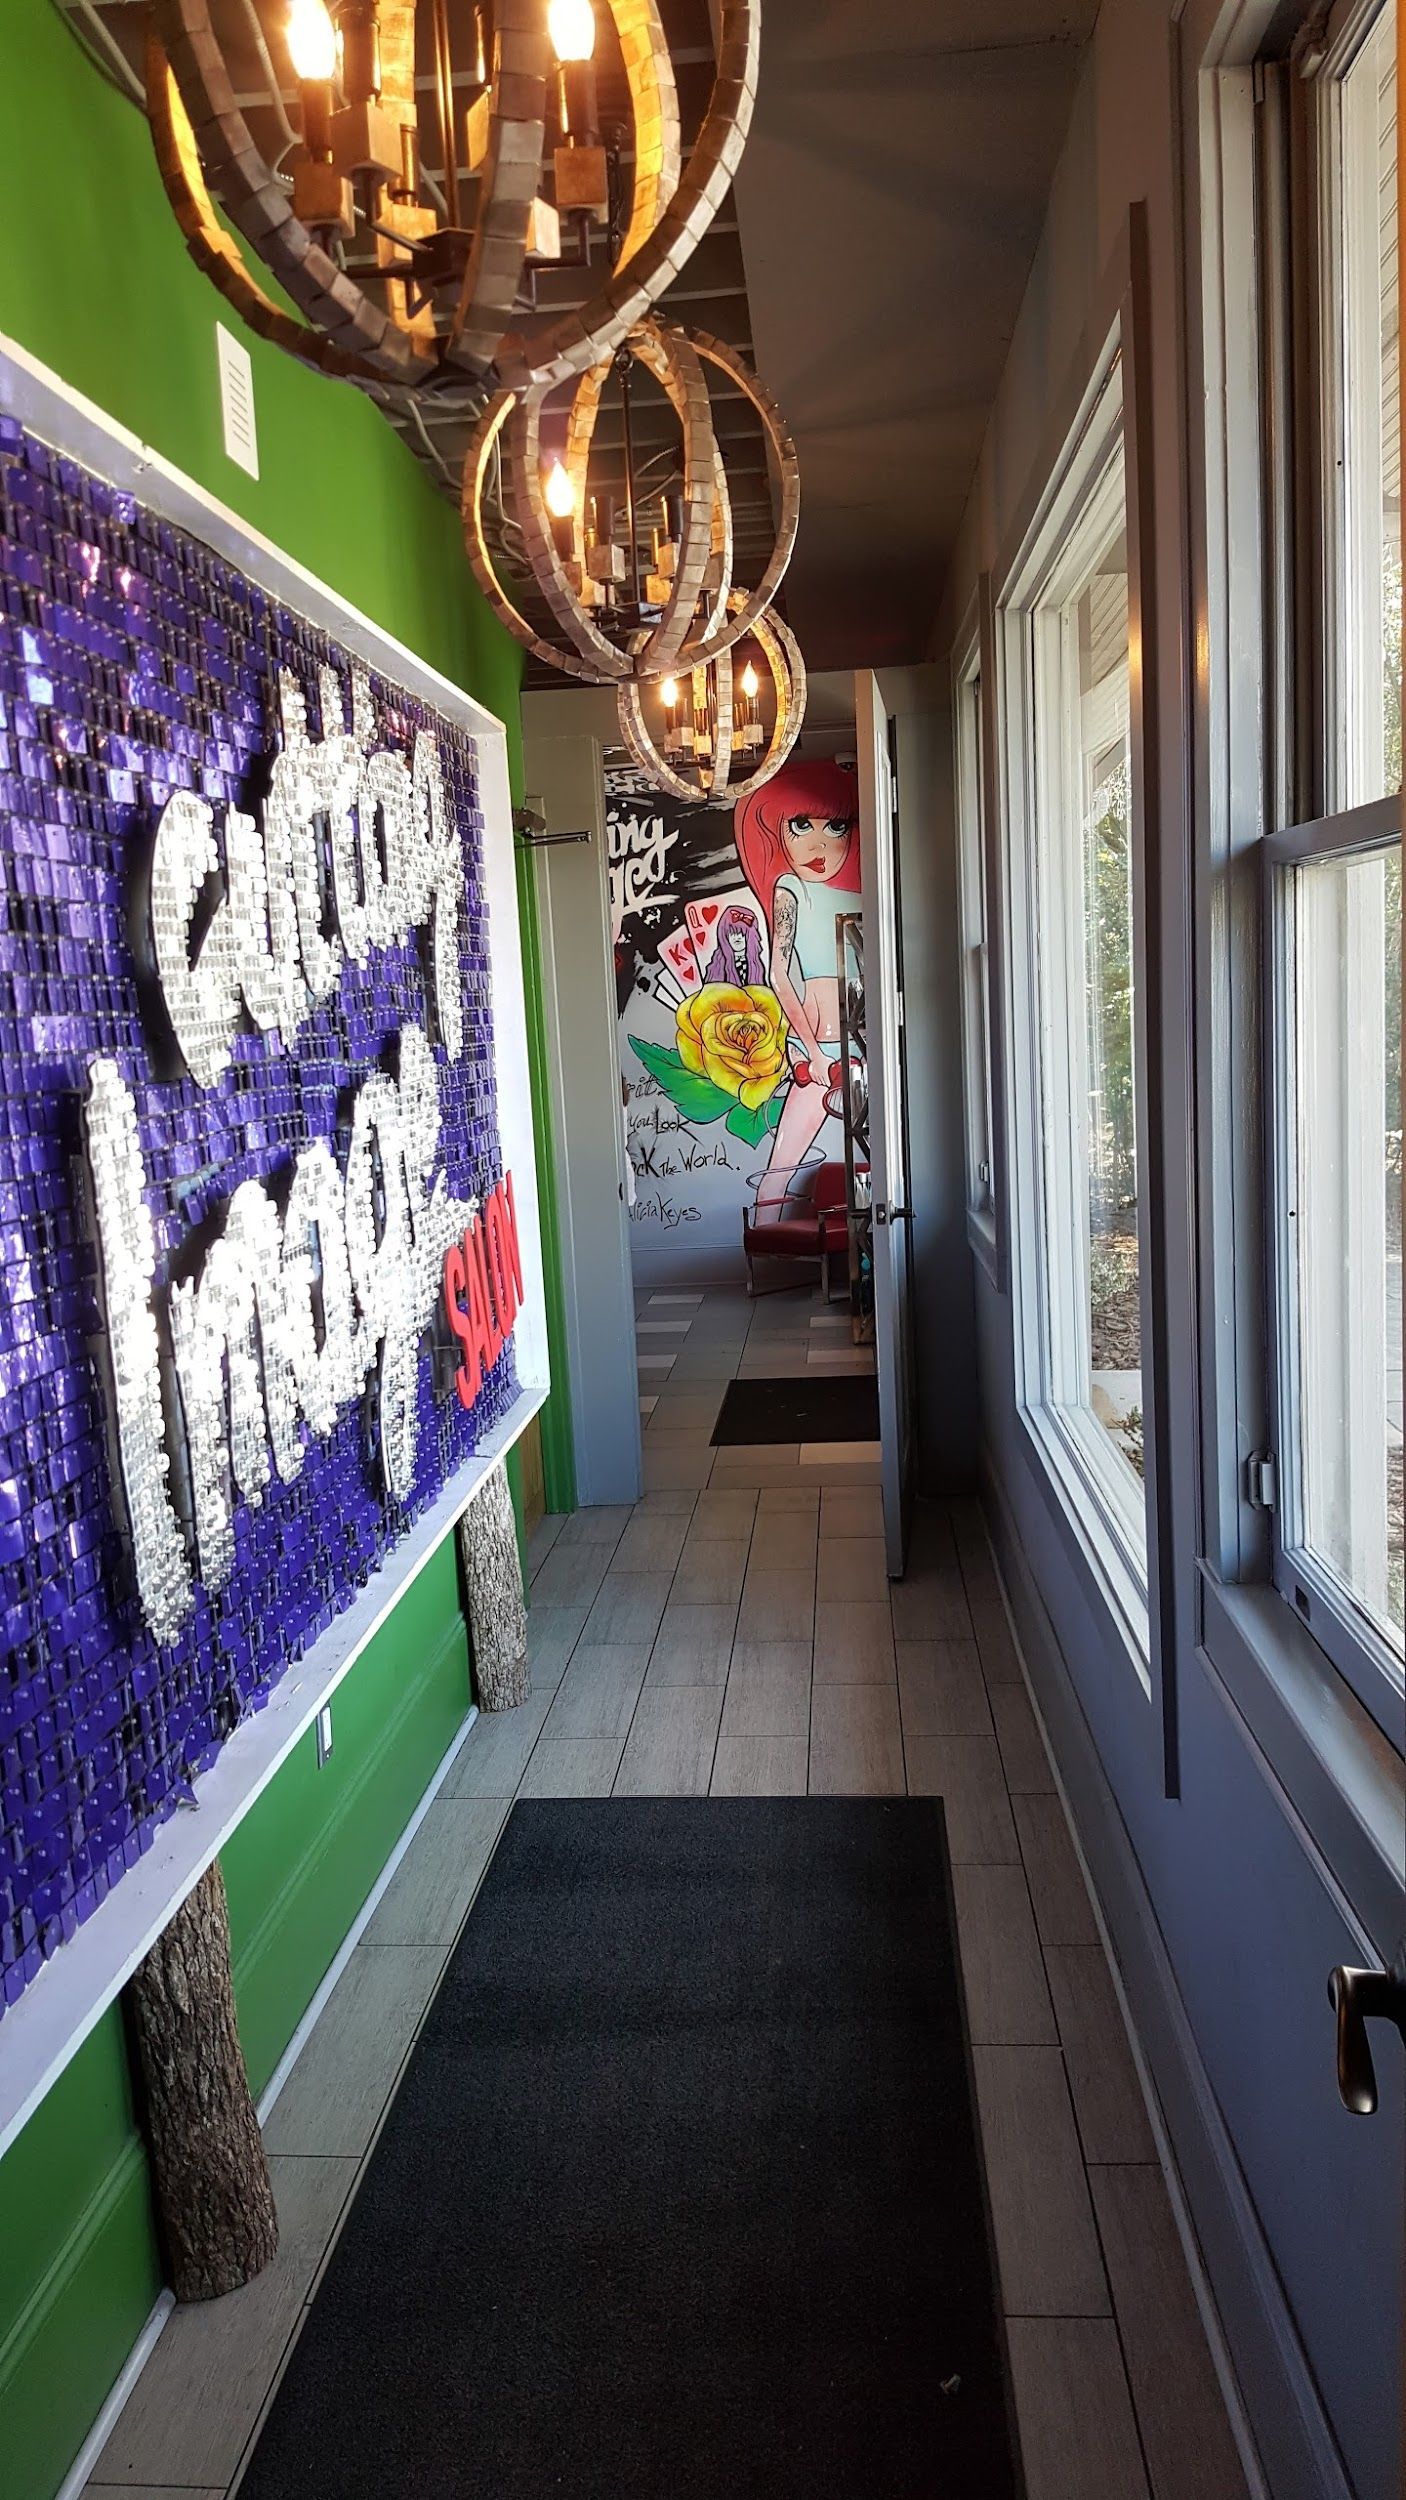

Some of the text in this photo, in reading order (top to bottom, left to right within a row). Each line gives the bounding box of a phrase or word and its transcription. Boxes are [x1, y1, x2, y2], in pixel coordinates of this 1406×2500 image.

[687, 905, 703, 929] Q
[668, 943, 688, 967] K
[444, 1169, 524, 1409] SALON
